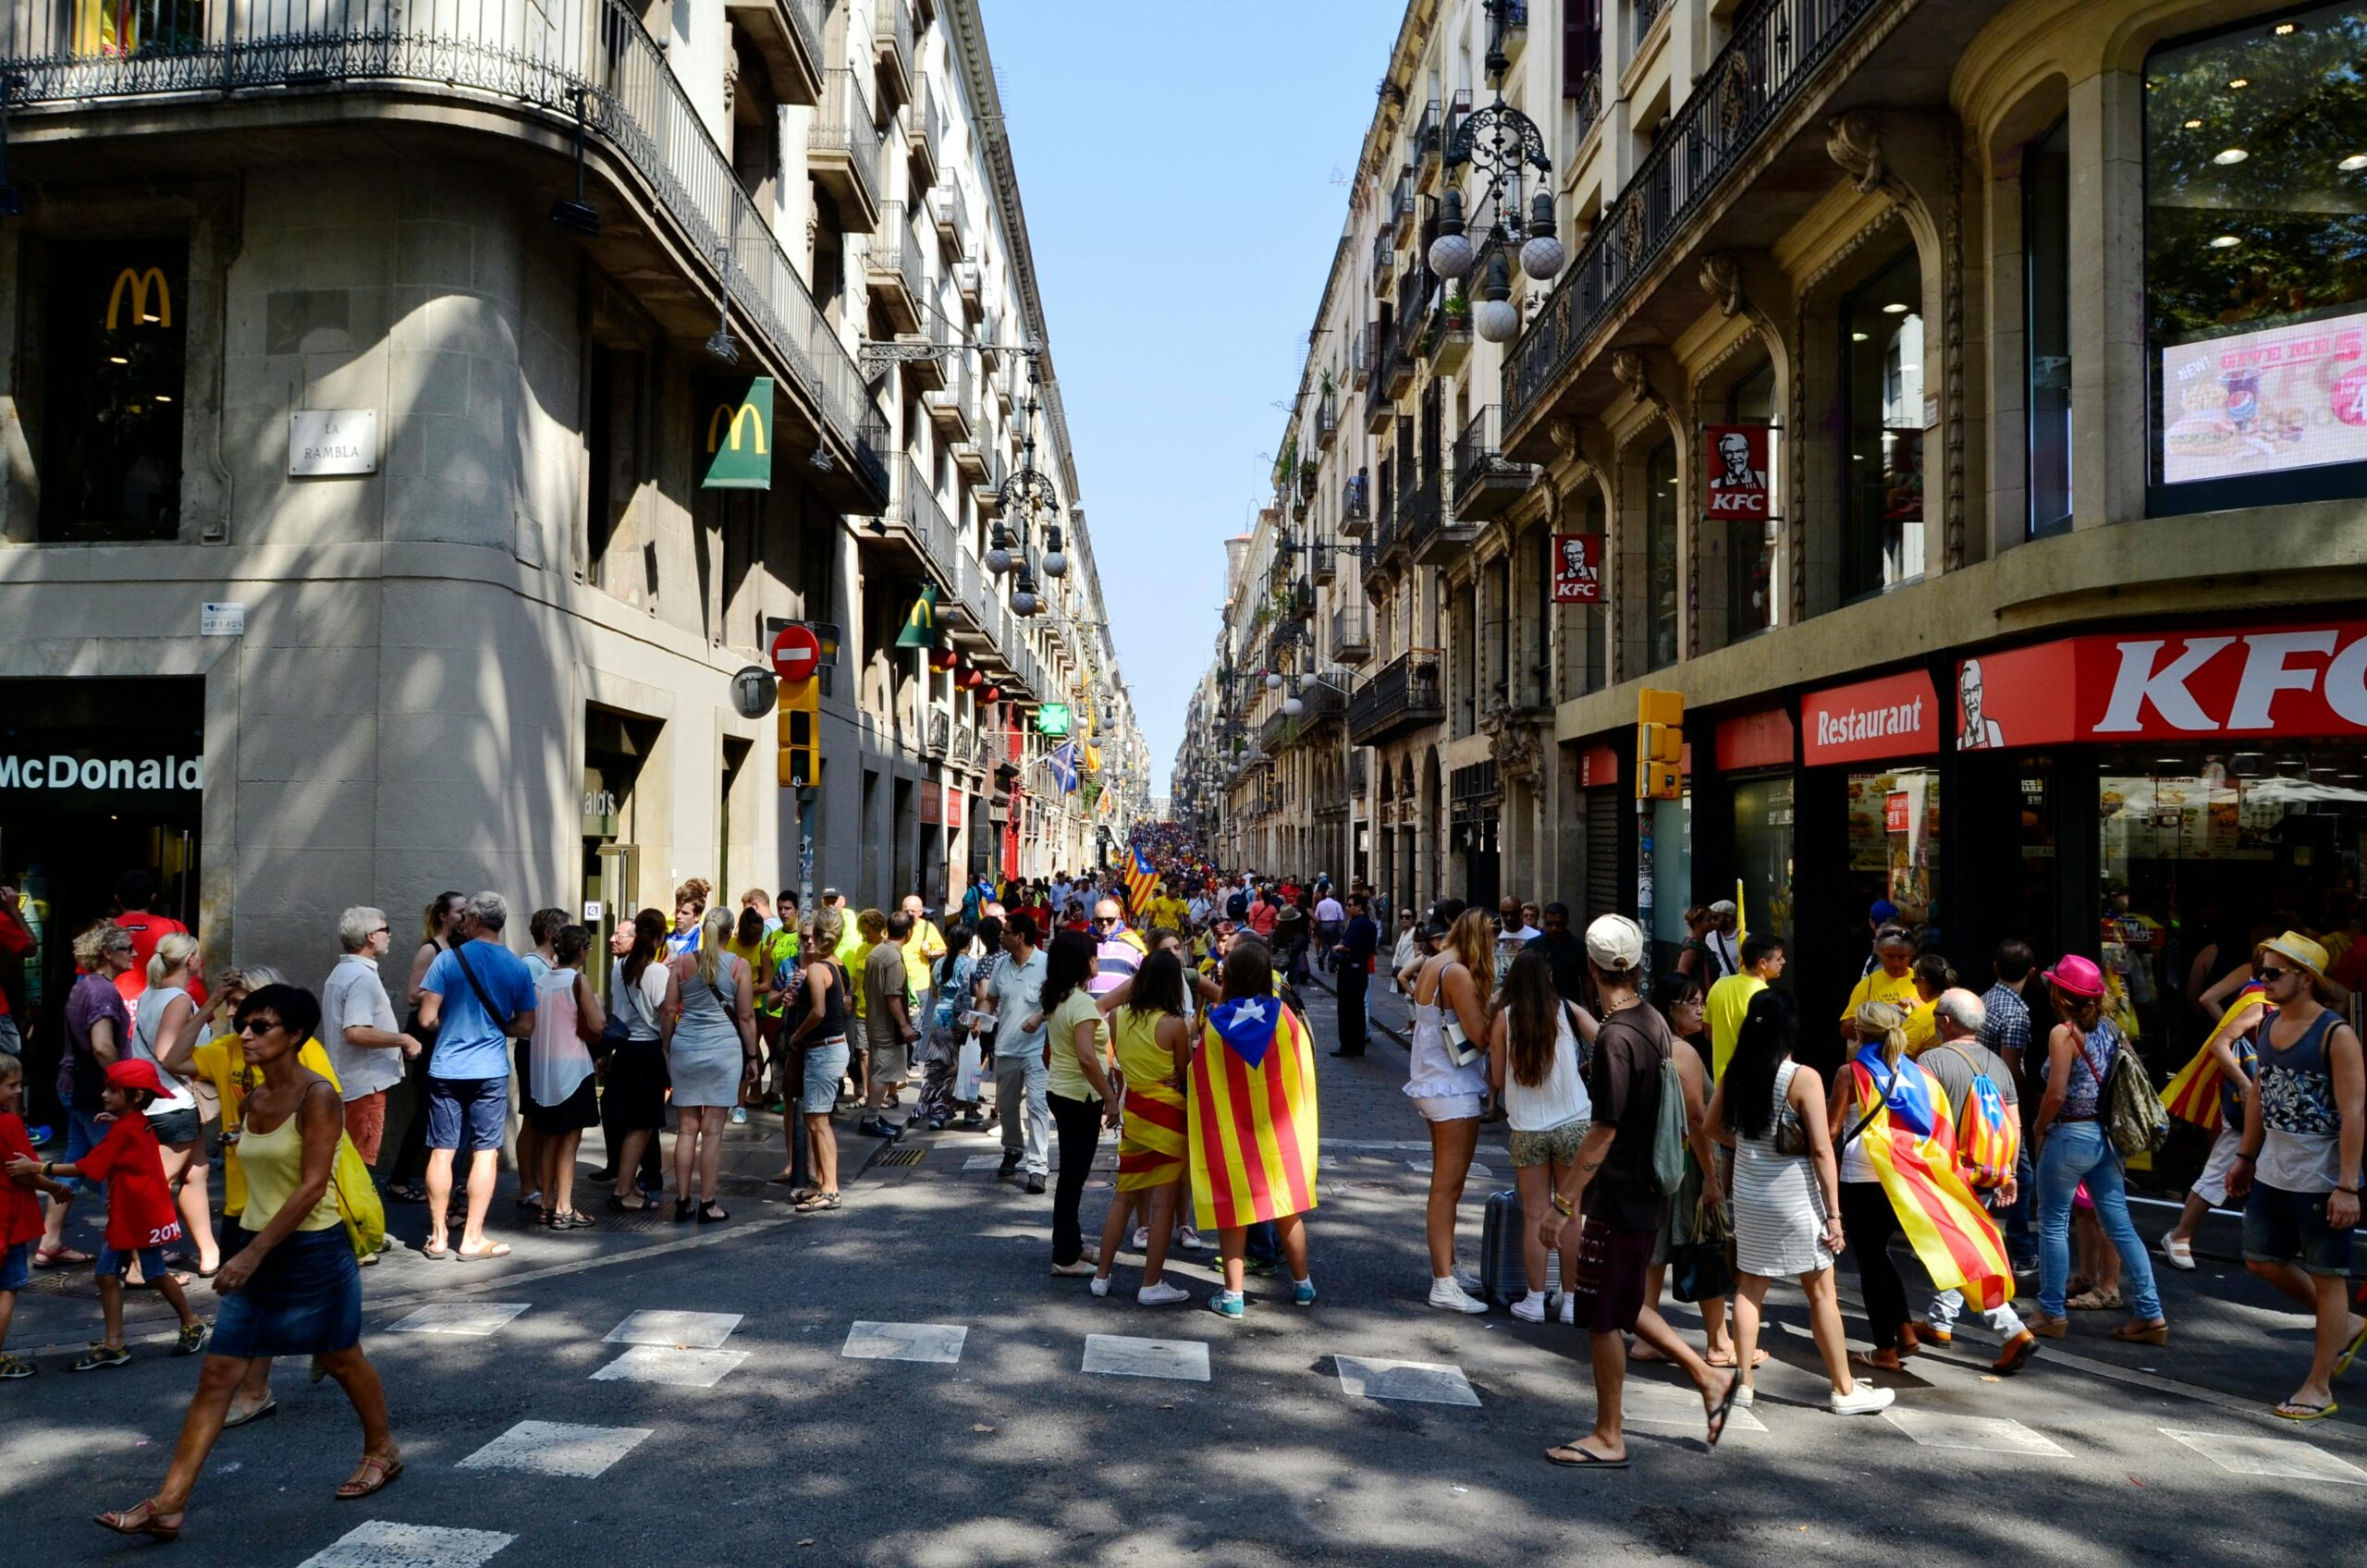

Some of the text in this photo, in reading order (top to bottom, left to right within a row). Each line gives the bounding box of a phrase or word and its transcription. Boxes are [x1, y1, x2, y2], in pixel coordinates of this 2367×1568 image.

[2220, 331, 2362, 370] GIVE ME 5
[2177, 356, 2210, 381] NEW!
[325, 424, 339, 435] LA
[304, 446, 360, 459] RAMBLA
[1711, 493, 1763, 510] KFC
[1557, 583, 1596, 596] KFC
[1817, 694, 1922, 746] Restaurant
